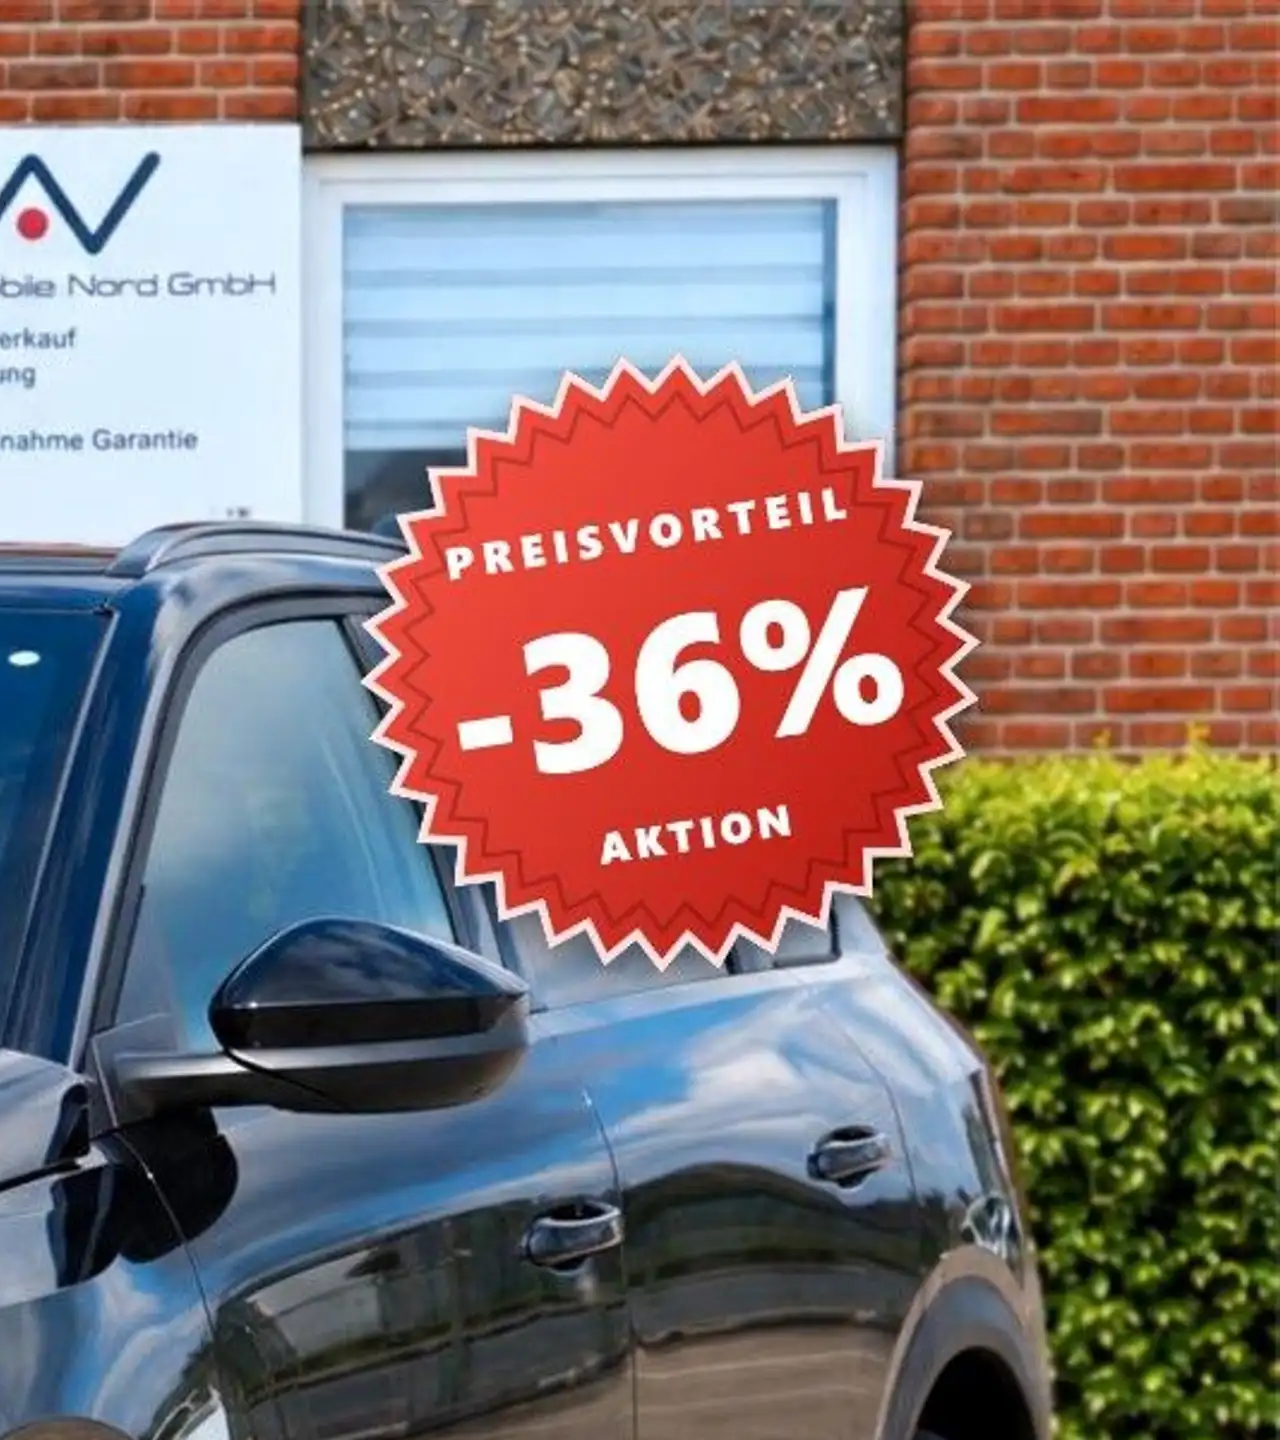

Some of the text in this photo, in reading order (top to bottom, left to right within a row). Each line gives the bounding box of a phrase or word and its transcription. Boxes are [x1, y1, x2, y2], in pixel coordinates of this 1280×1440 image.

[68, 273, 159, 298] Nord
[167, 272, 277, 297] GmbH
[91, 428, 199, 452] Garantie
